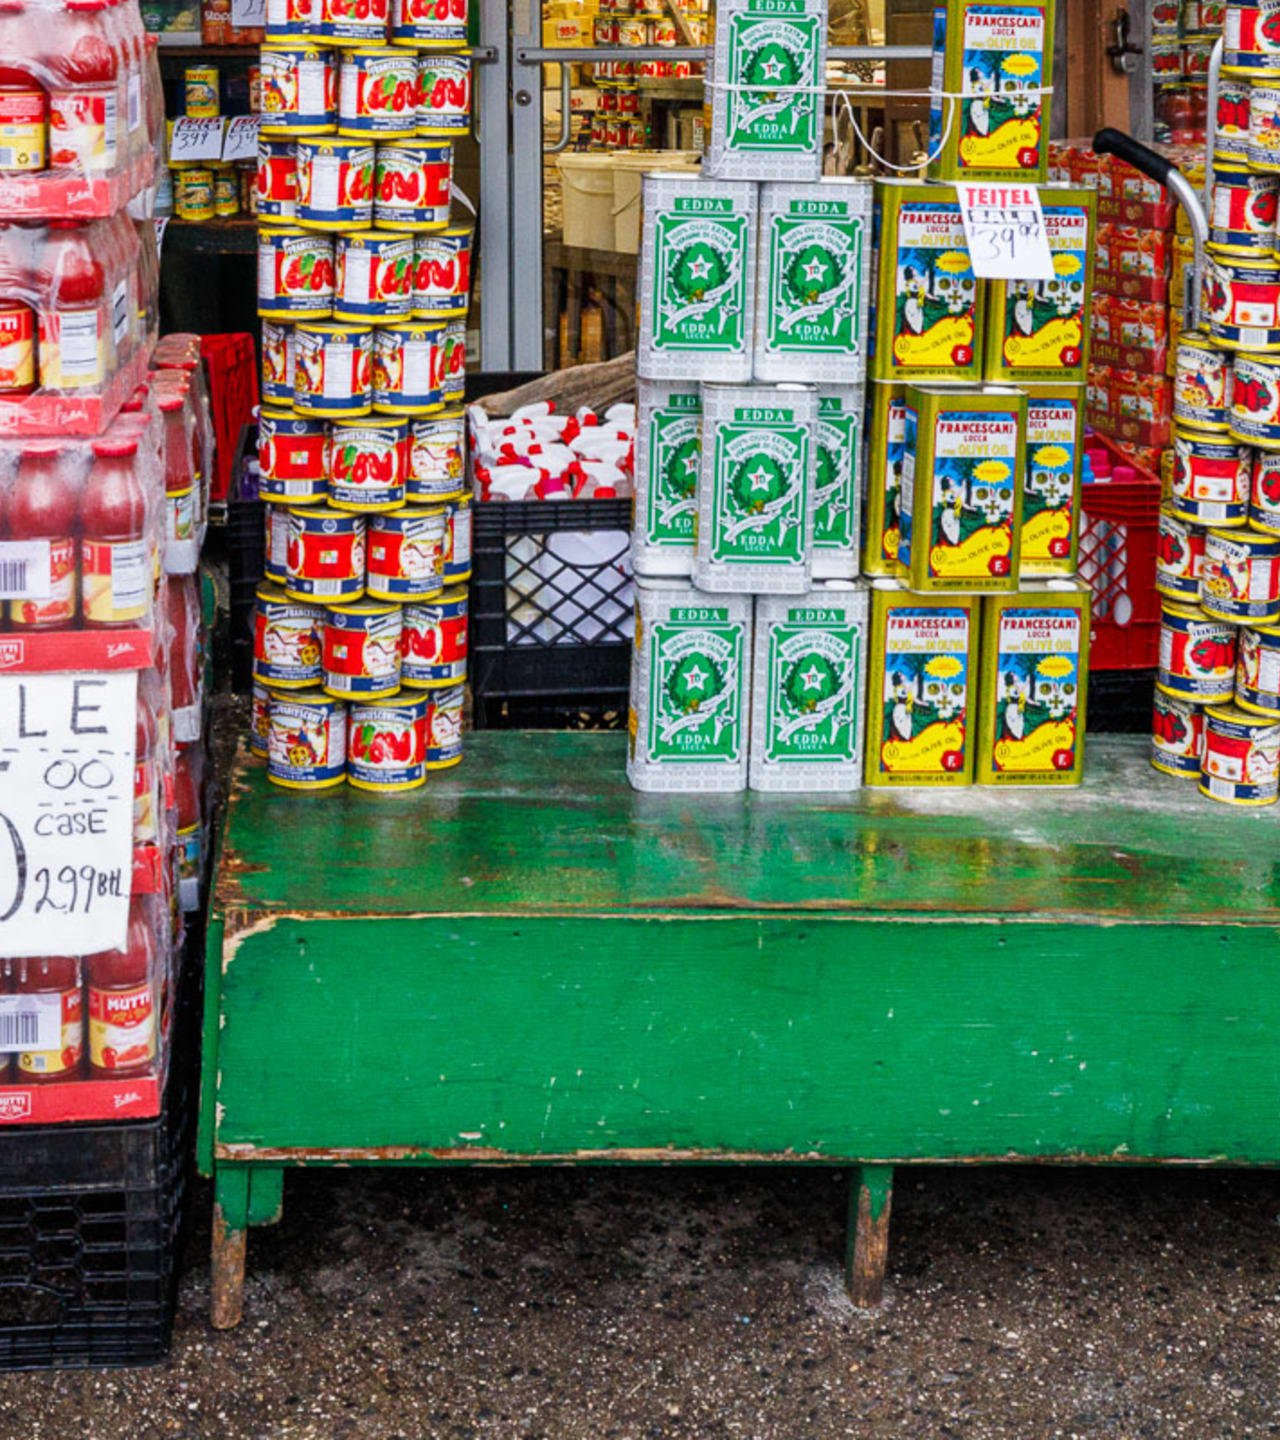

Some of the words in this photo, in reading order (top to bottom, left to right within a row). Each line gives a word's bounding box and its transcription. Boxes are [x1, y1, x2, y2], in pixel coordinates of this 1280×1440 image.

[755, 0, 797, 12] EDDA
[985, 37, 1018, 49] OLIVE
[1019, 37, 1037, 49] OIL
[754, 123, 788, 134] EDDA
[966, 188, 1034, 208] TEITEL
[682, 198, 725, 211] EDDA
[797, 201, 840, 214] EDDA
[681, 322, 716, 334] EDDA
[795, 324, 830, 336] EDDA
[742, 410, 786, 421] EDDA
[991, 444, 1008, 455] OIL
[740, 535, 776, 546] EDDA
[677, 609, 720, 621] EDDA
[795, 610, 838, 622] EDDA
[1022, 639, 1052, 651] OLIVE
[1055, 639, 1072, 651] OIL
[676, 734, 711, 745] EDDA
[793, 734, 828, 745] EDDA
[107, 992, 151, 1010] MUTTI
